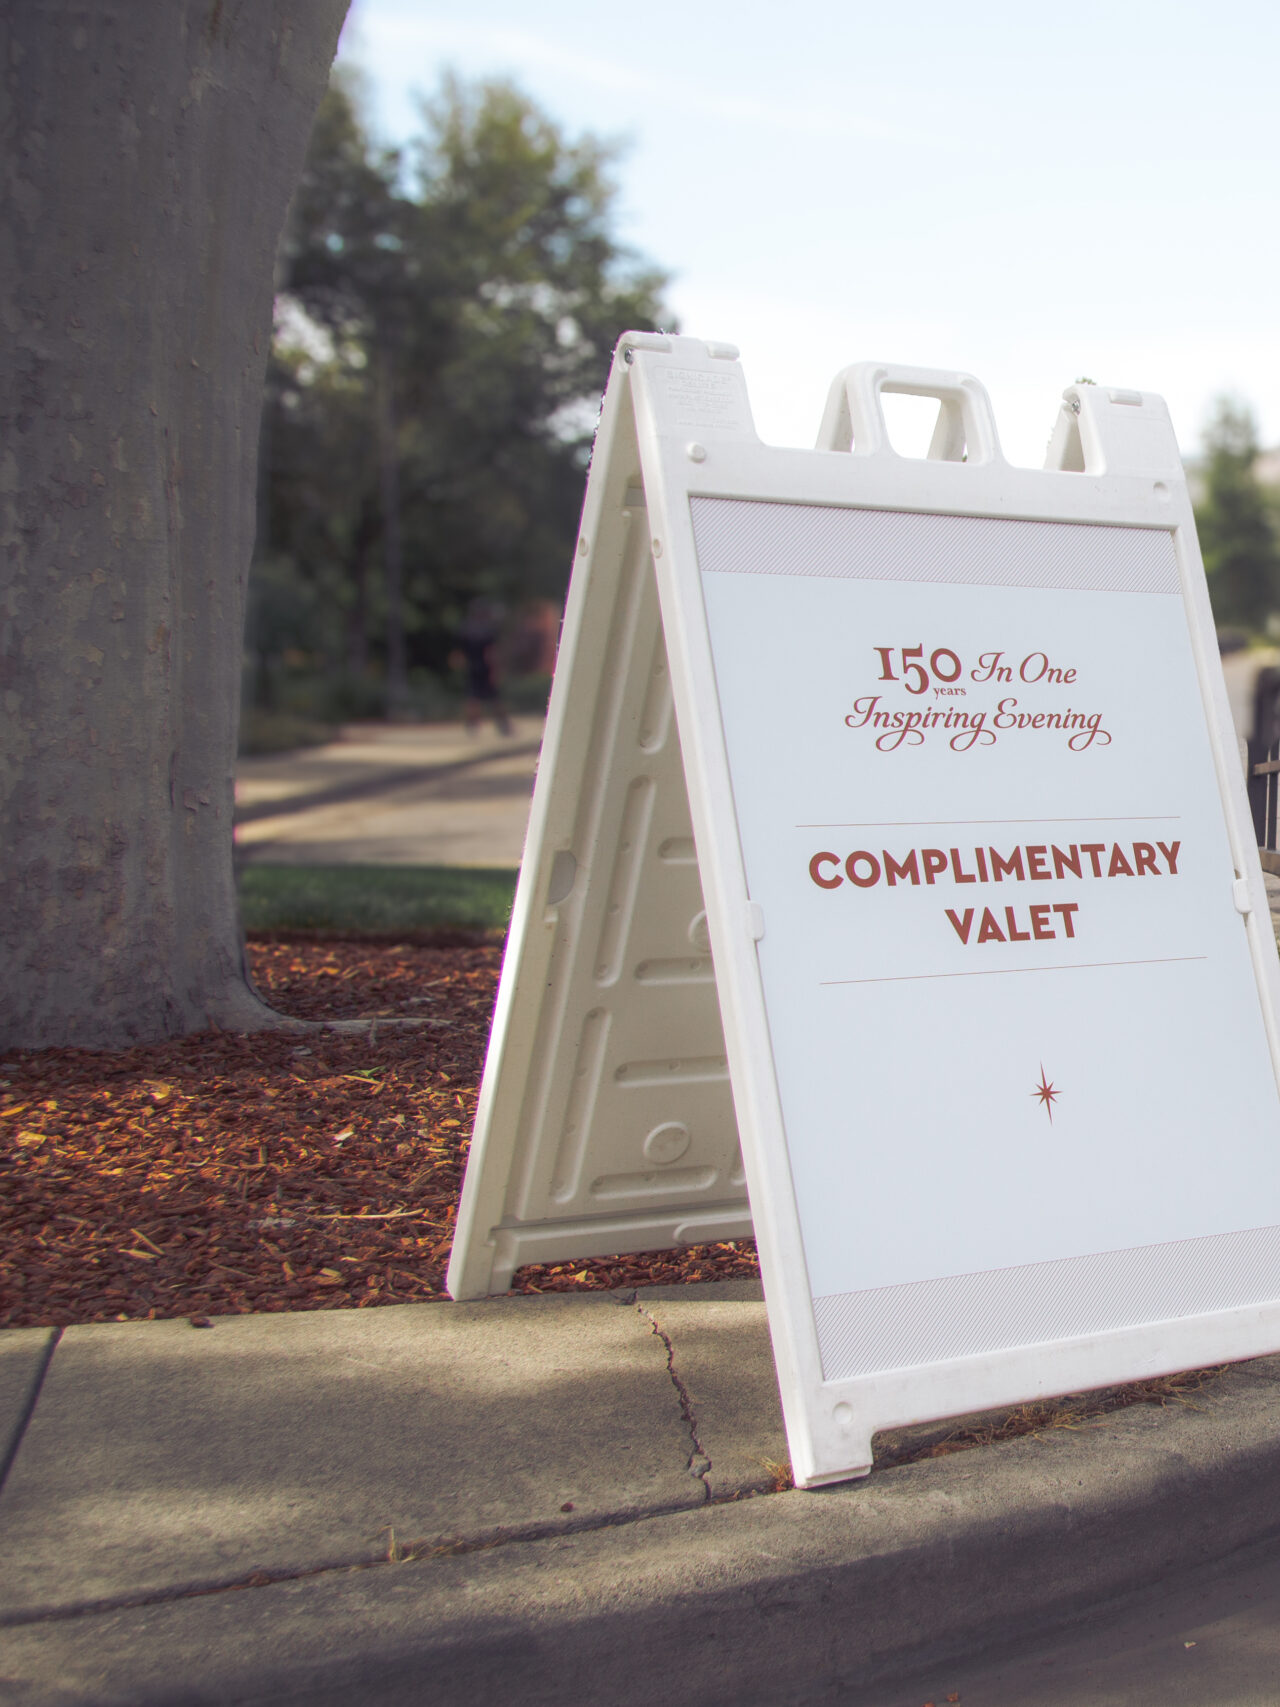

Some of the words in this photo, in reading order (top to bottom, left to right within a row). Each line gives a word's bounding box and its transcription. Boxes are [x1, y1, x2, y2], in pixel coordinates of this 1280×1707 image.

[873, 643, 963, 695] 150
[969, 651, 1013, 684] In
[1018, 651, 1078, 684] One
[932, 686, 967, 700] years
[844, 695, 997, 752] Inspiring
[992, 697, 1113, 752] Evening
[808, 840, 1182, 890] COMPLIMENTARY
[944, 902, 1080, 946] VALET
